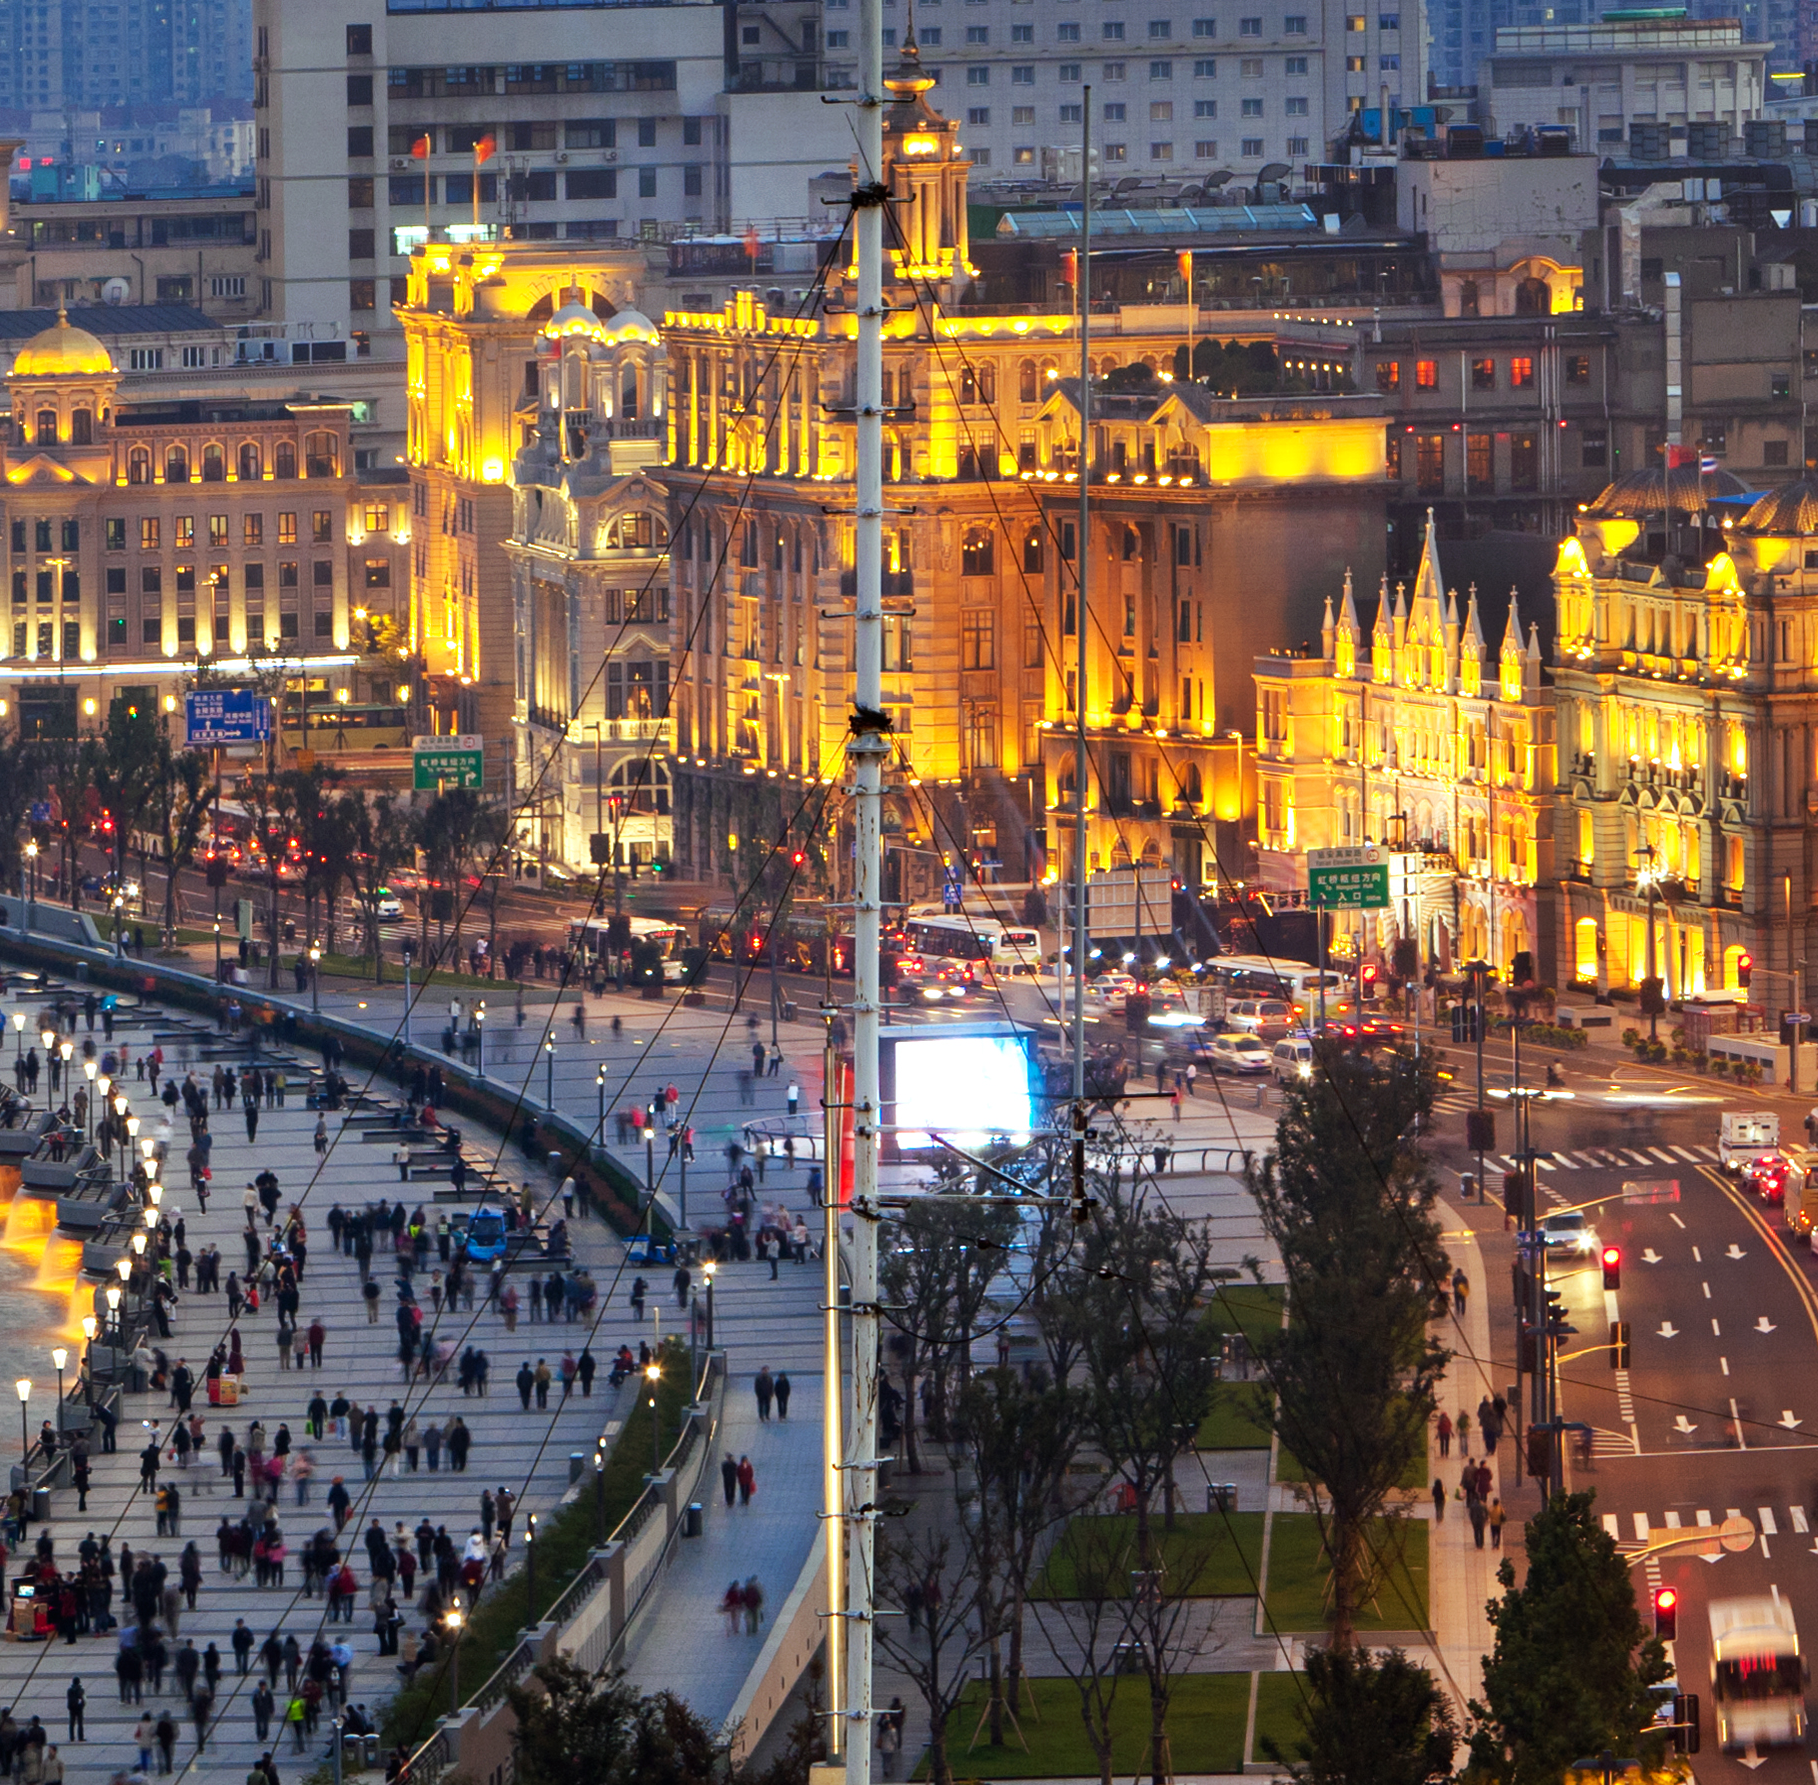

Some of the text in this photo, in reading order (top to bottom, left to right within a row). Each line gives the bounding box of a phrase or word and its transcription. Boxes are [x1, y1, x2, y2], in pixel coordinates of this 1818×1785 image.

[194, 694, 223, 702] 南浦大桥
[421, 757, 476, 766] 虹桥枢纽方向
[1317, 849, 1362, 859] 延安高架路
[1317, 872, 1381, 885] 虹桥枢纽方向
[1338, 892, 1361, 901] 入口
